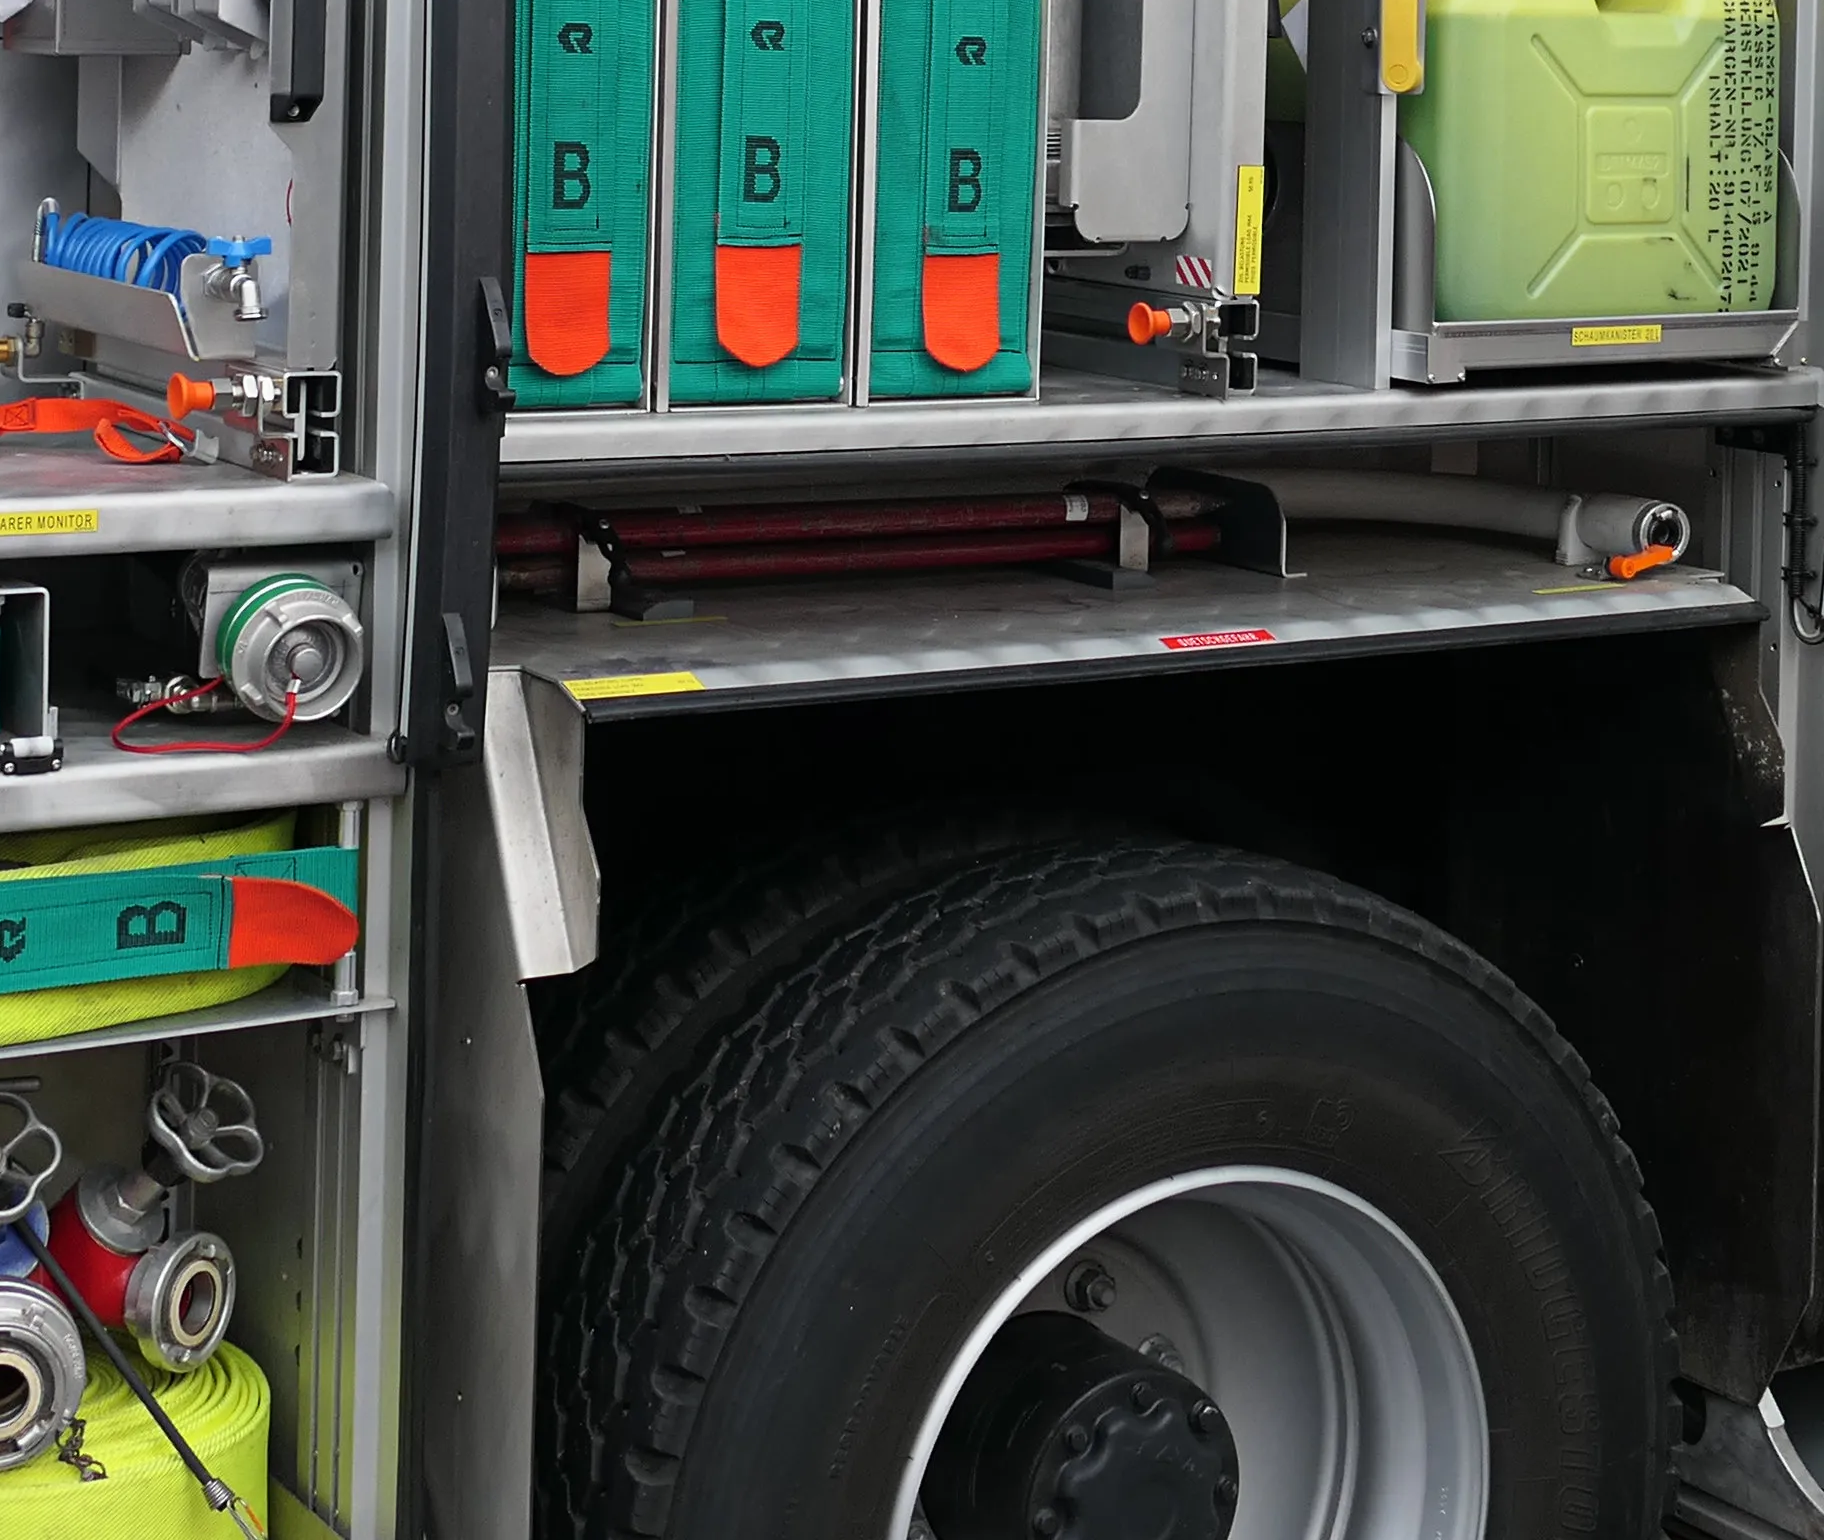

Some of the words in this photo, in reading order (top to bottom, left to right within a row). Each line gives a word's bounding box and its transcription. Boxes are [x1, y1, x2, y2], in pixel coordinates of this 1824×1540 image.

[551, 140, 591, 211] B
[743, 136, 781, 203] B
[948, 148, 983, 213] B
[37, 513, 93, 529] MONITOR
[116, 898, 187, 950] B
